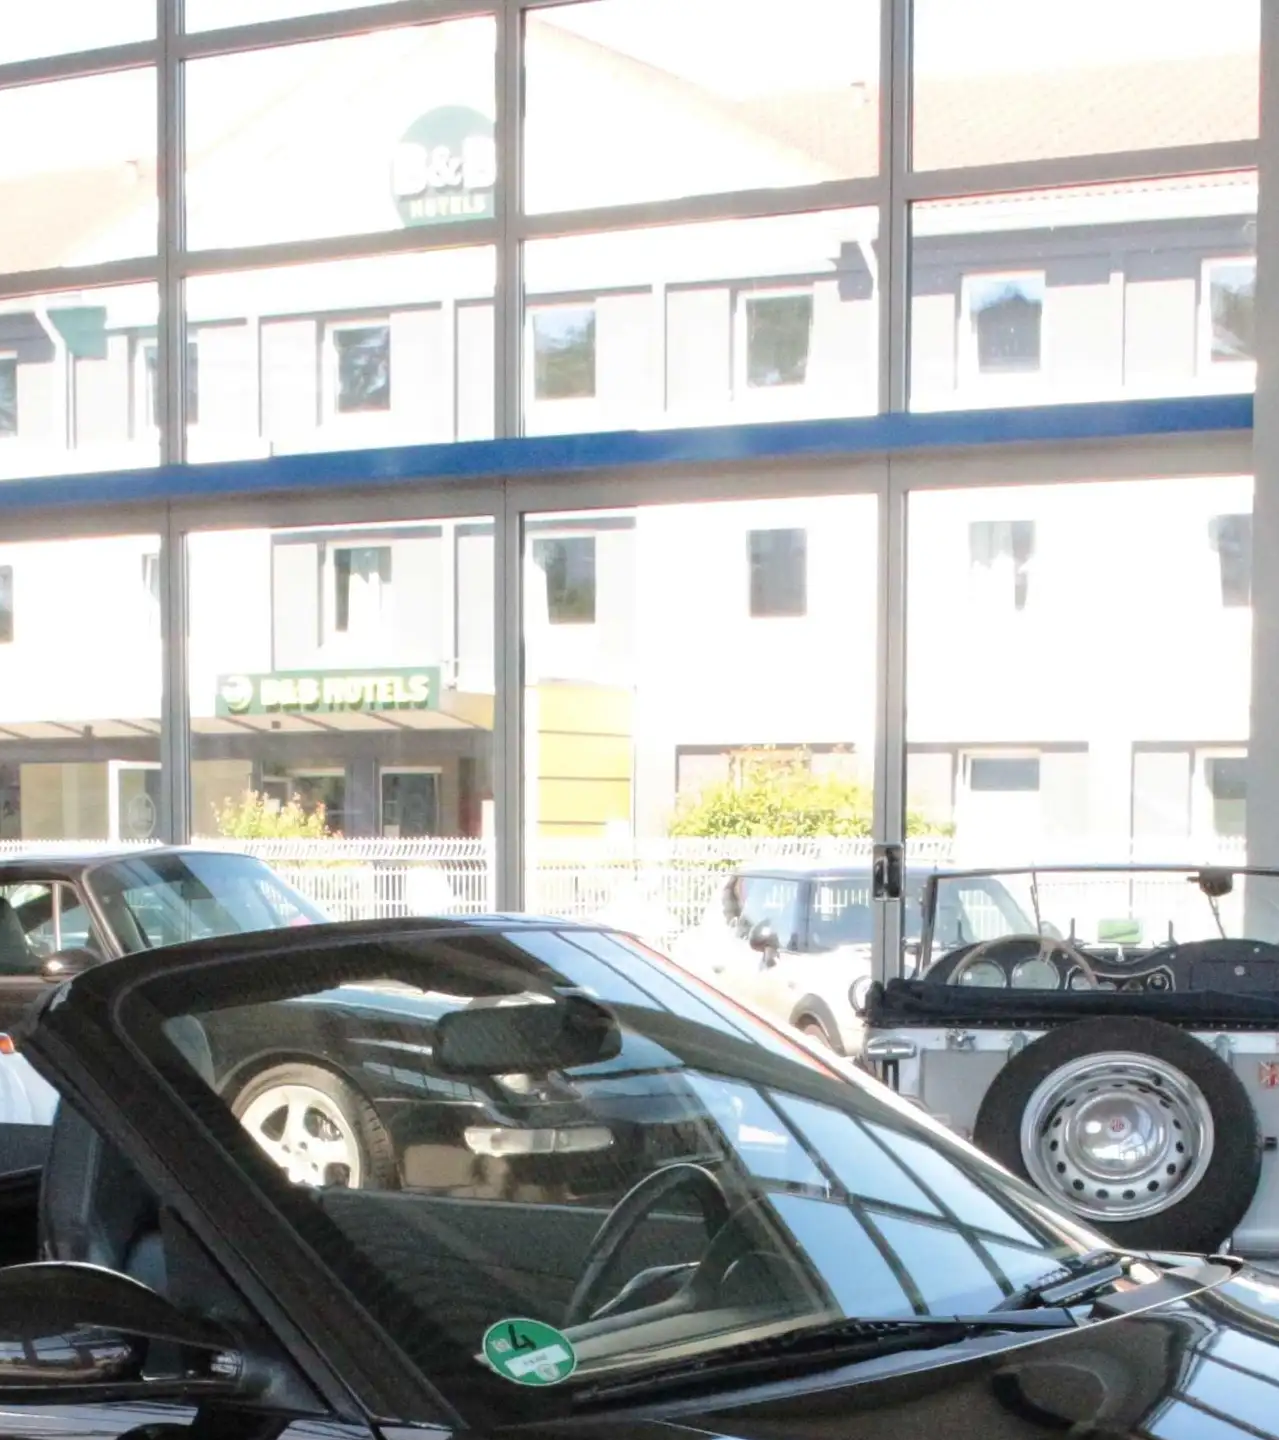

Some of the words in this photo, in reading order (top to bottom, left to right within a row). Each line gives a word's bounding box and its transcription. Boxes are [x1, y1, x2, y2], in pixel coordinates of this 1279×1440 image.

[410, 193, 486, 218] HOTELS
[260, 676, 320, 708] B&B
[322, 675, 429, 706] HOTELS
[508, 1324, 536, 1351] 4
